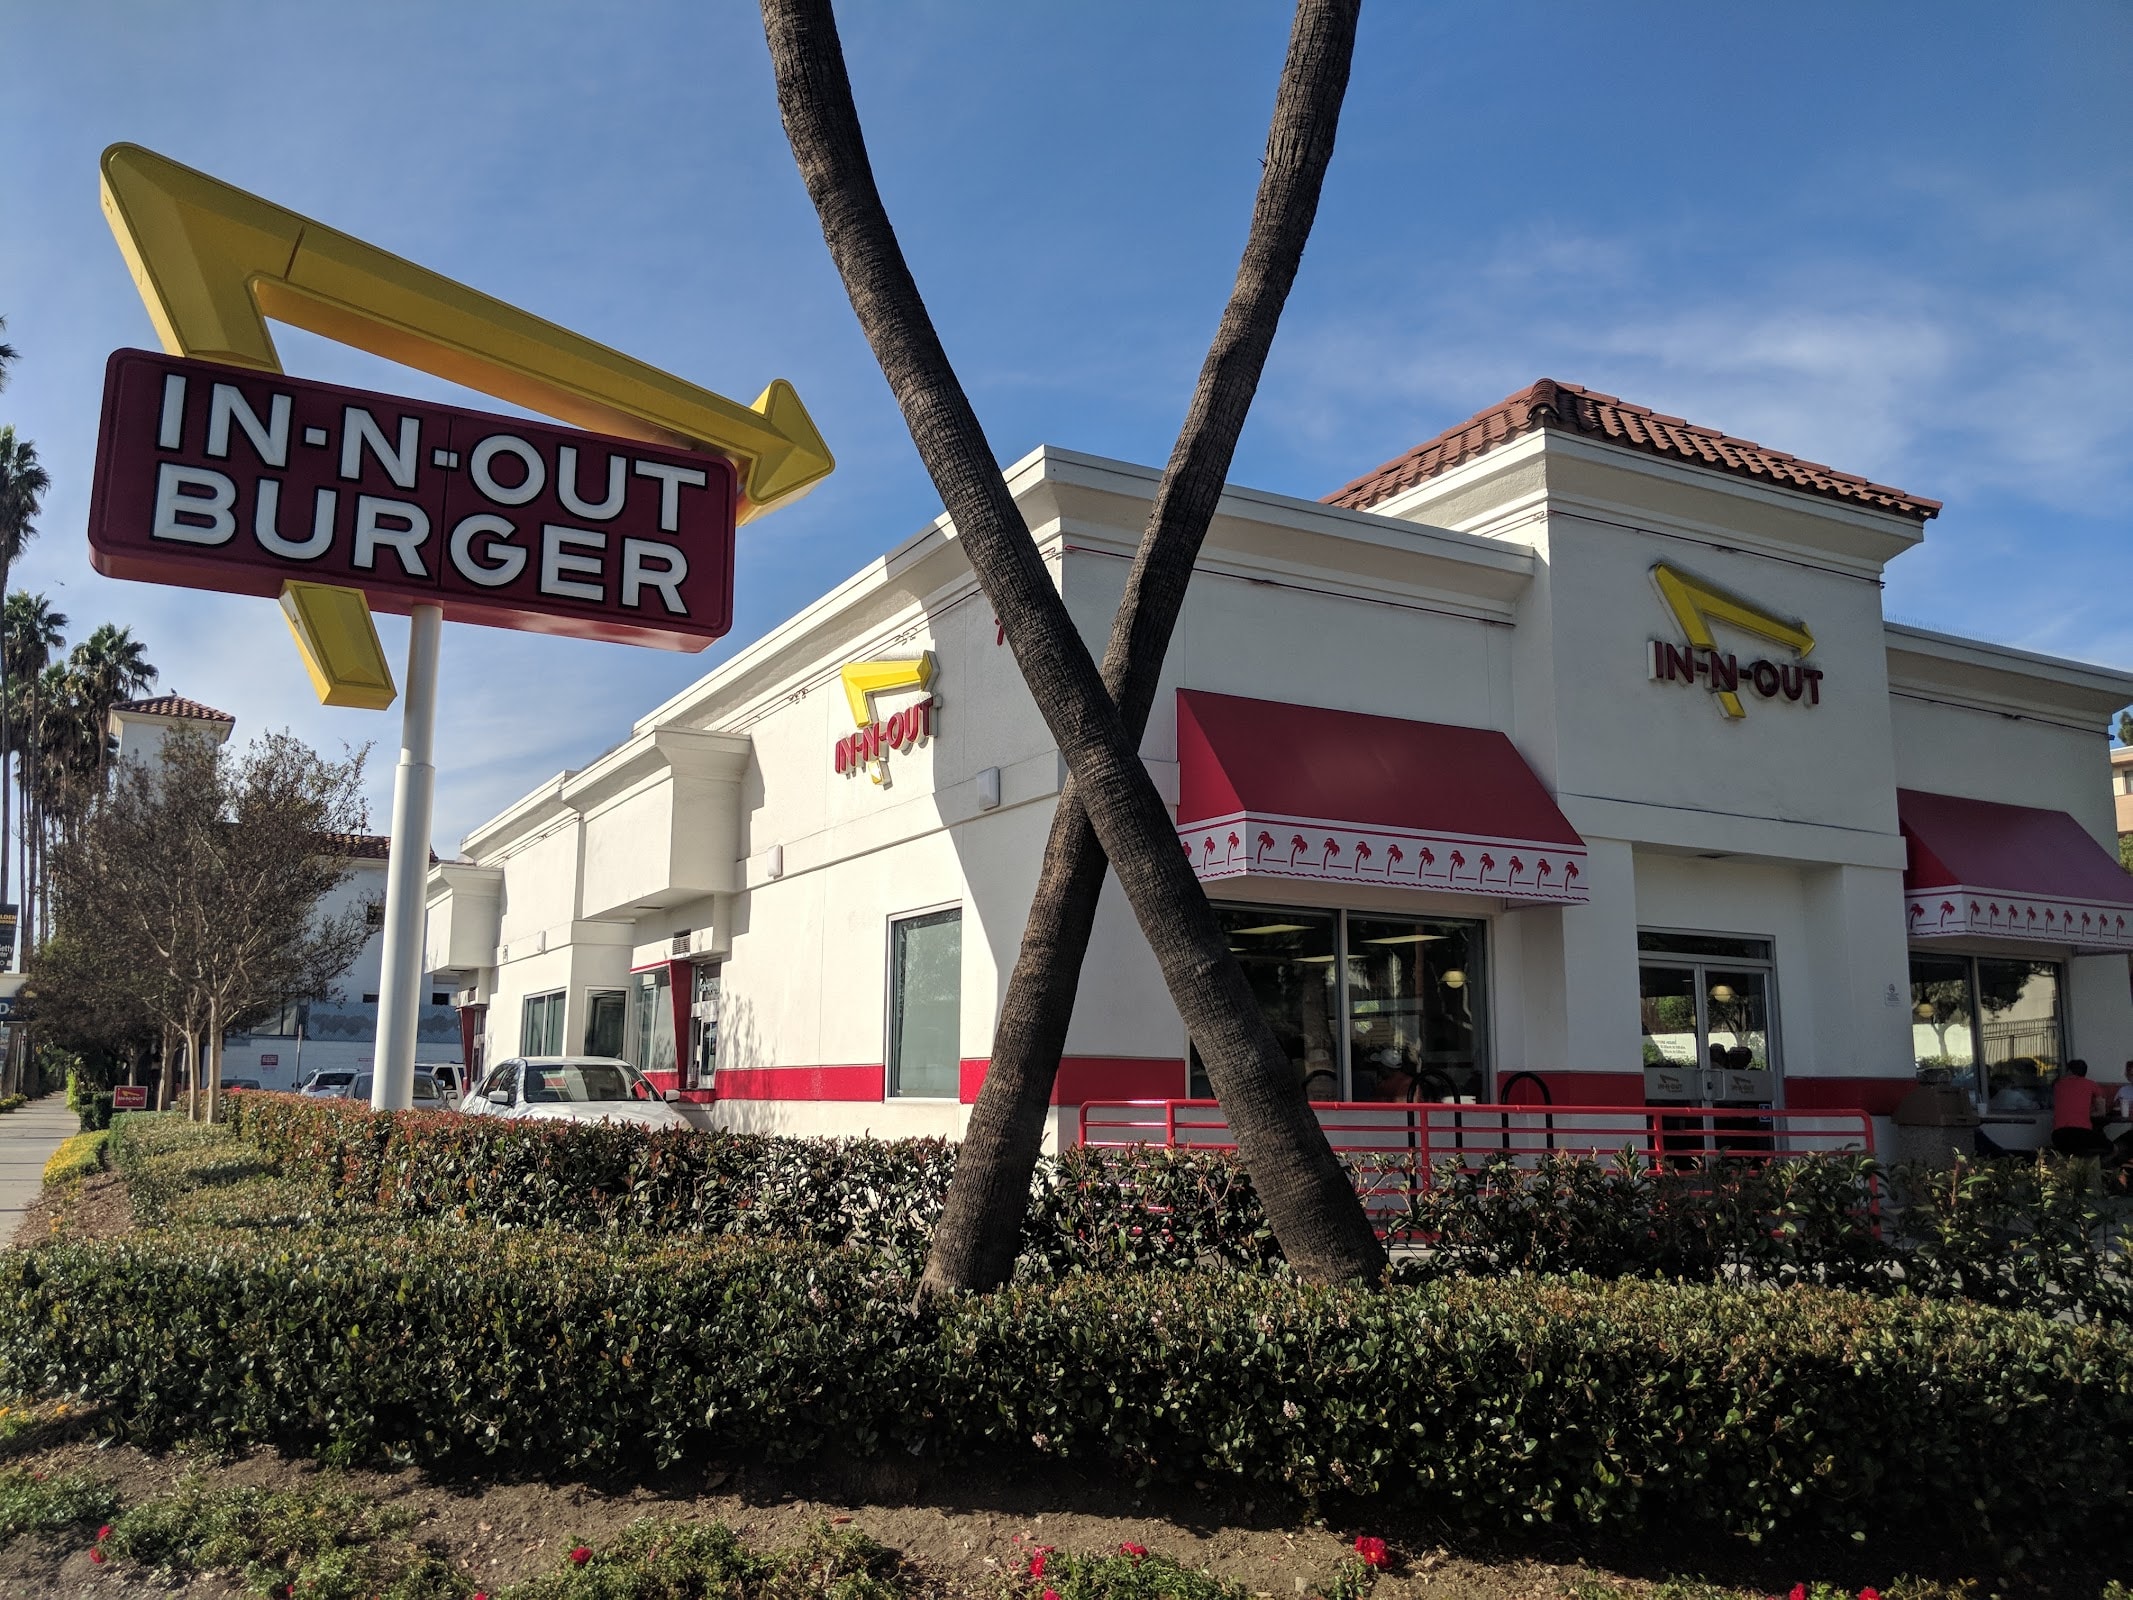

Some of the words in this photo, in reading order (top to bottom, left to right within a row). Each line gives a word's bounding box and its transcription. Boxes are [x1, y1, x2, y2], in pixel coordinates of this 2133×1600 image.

[157, 374, 707, 532] IN-N-OUT
[151, 461, 690, 615] BURGER
[1648, 640, 1823, 705] IN-N-OUT
[835, 696, 933, 774] IN-N-OUT
